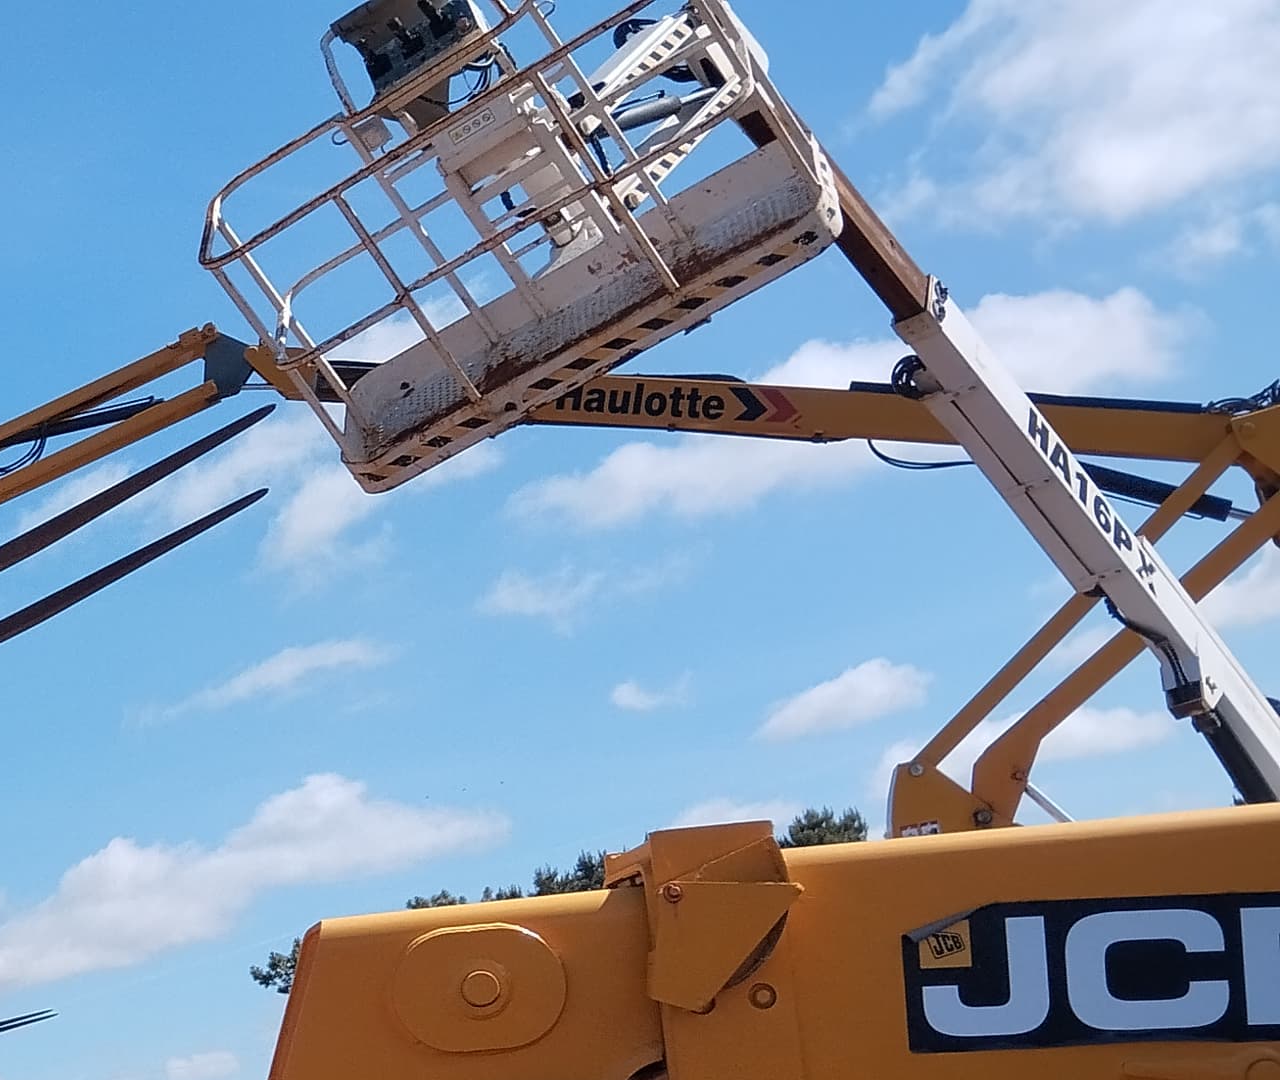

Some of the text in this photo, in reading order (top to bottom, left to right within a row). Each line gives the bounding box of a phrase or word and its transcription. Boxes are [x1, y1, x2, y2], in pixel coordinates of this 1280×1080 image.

[555, 383, 726, 420] Haulotte
[930, 931, 965, 956] JCB
[922, 907, 1280, 1037] JC
